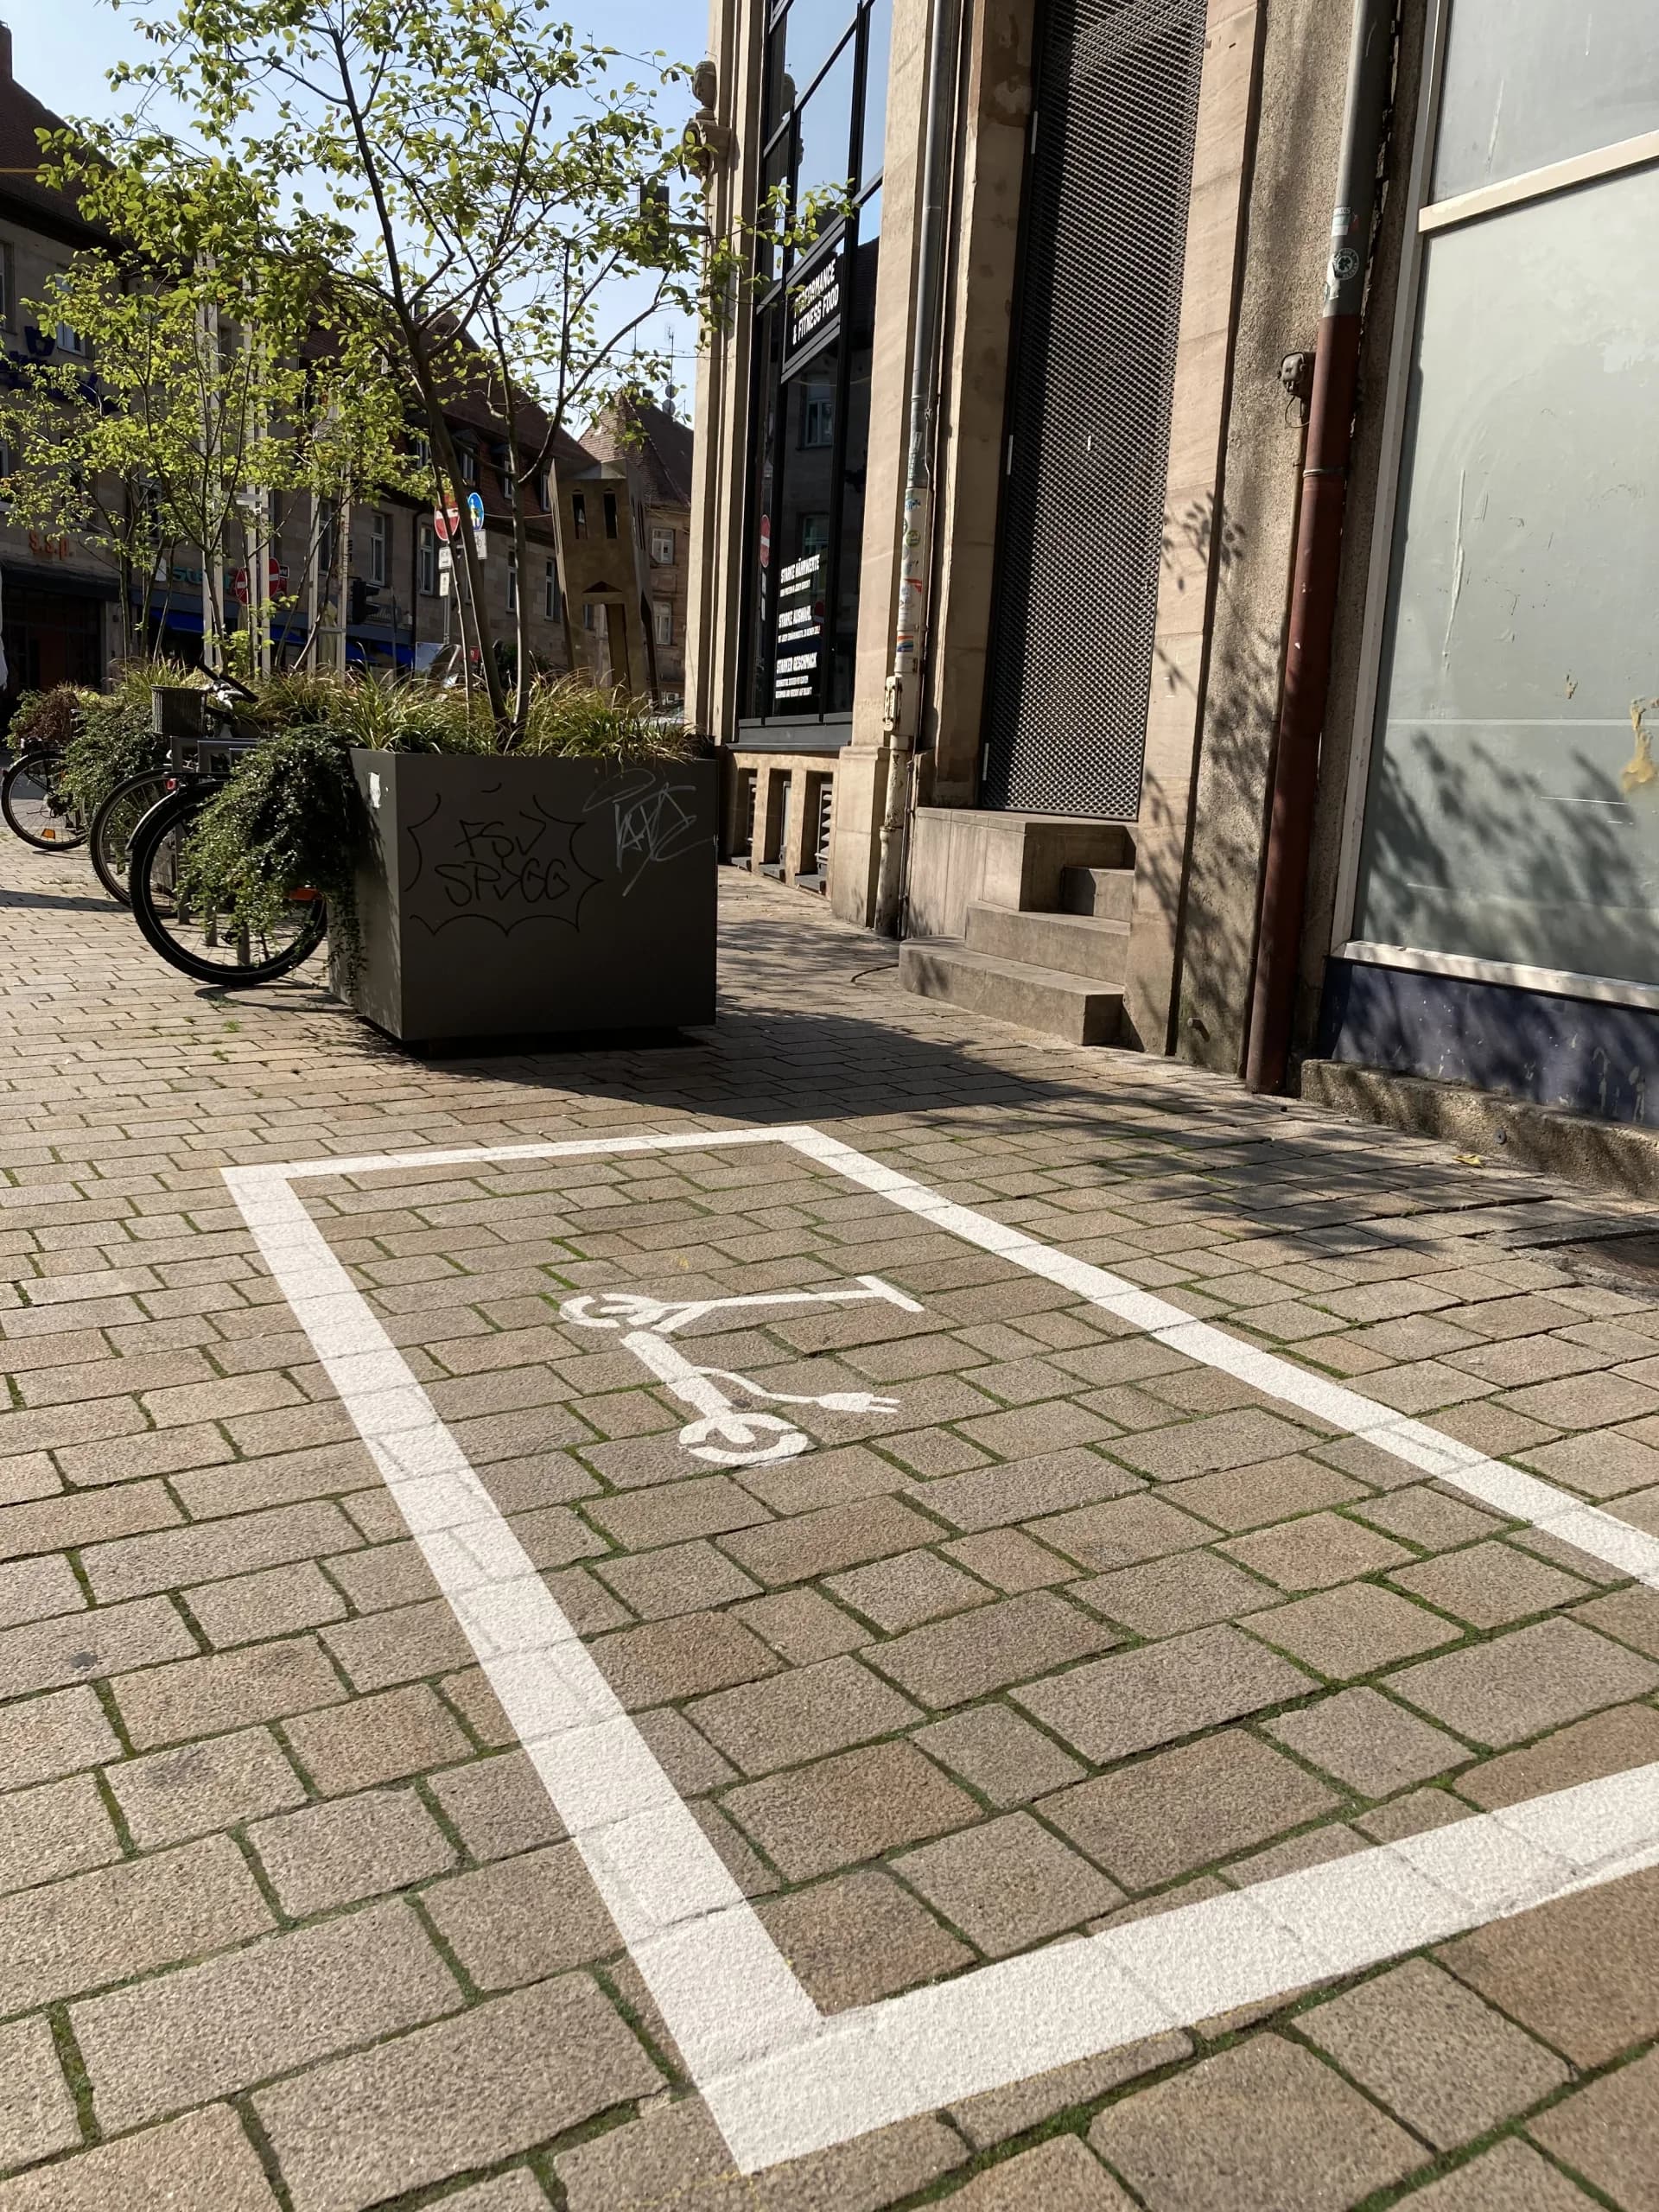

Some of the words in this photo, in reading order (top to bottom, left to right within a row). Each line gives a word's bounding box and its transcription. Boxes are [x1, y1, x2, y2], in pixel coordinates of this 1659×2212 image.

[792, 324, 797, 345] &
[798, 301, 822, 341] FITNESS
[823, 283, 839, 318] FOOD
